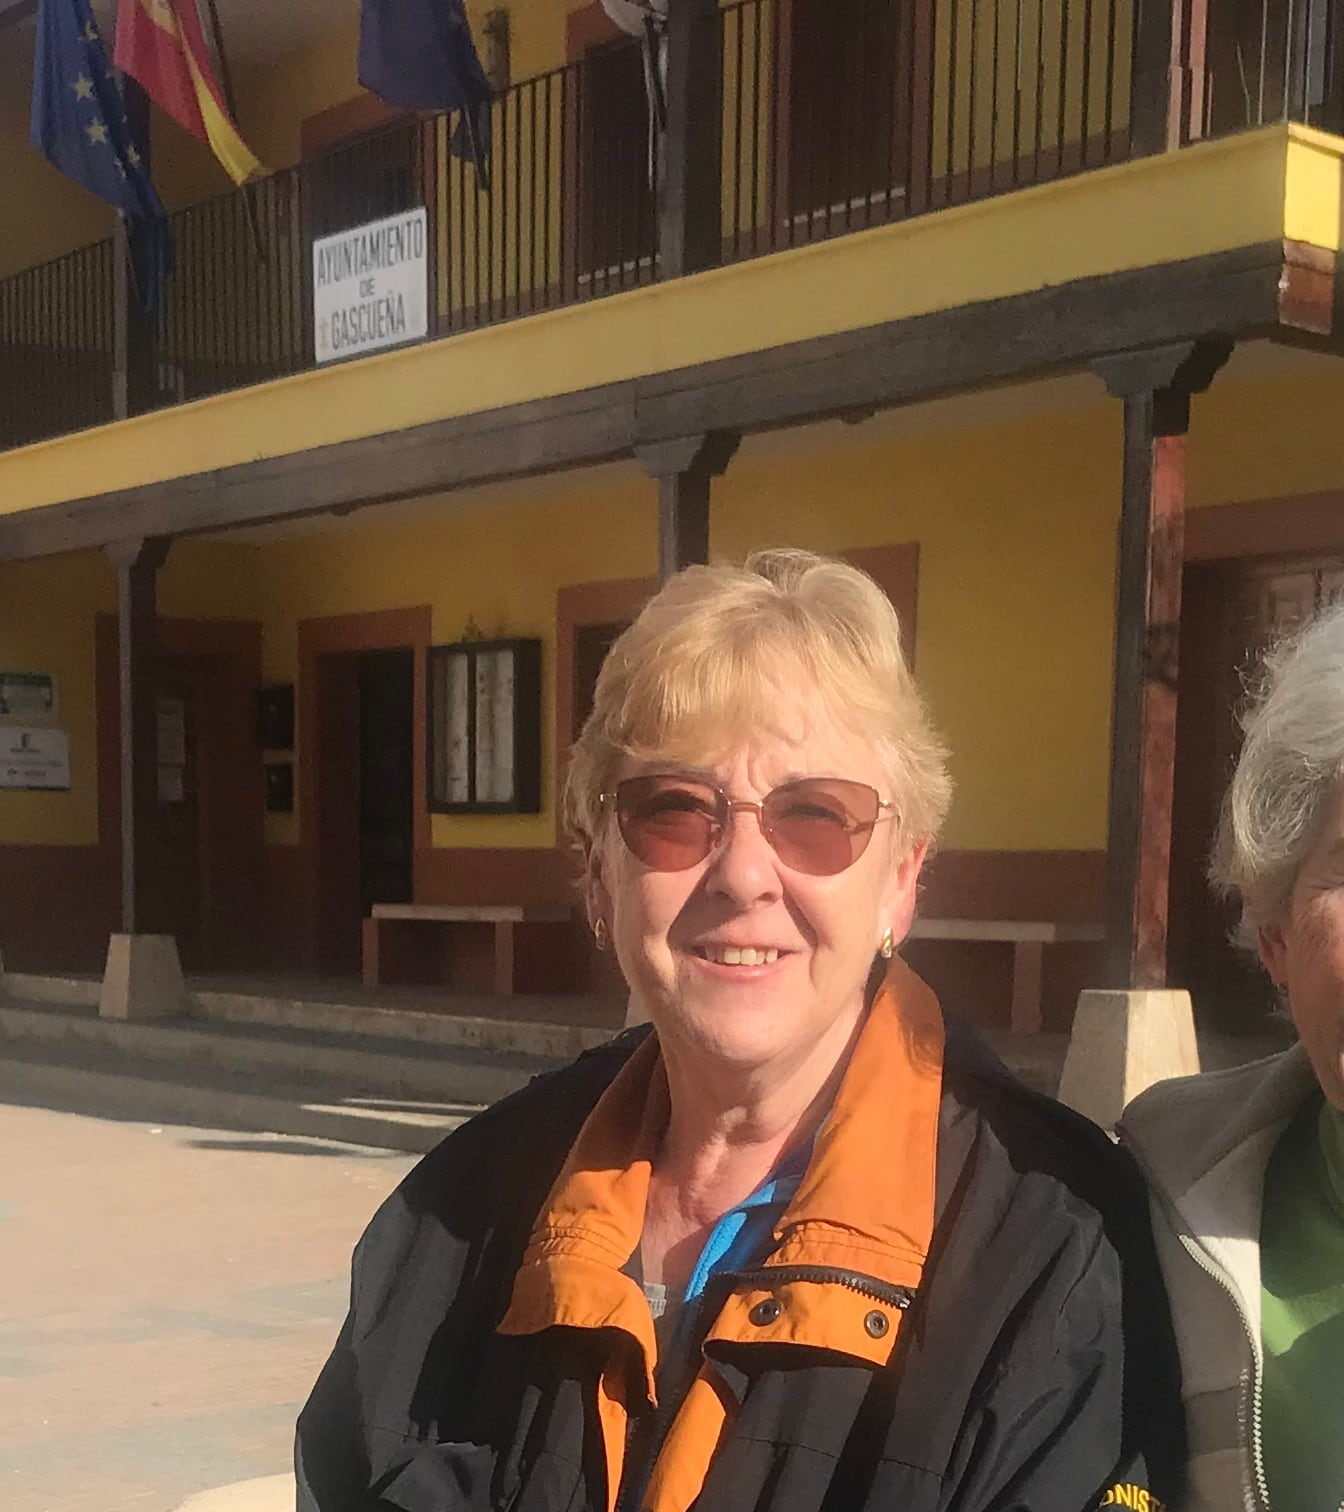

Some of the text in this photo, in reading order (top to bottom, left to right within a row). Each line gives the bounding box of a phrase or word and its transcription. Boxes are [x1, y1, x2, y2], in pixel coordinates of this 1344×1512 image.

[317, 218, 423, 287] AYUNTAMIENTO
[359, 277, 376, 298] DE
[331, 290, 406, 351] GASCUEÑA
